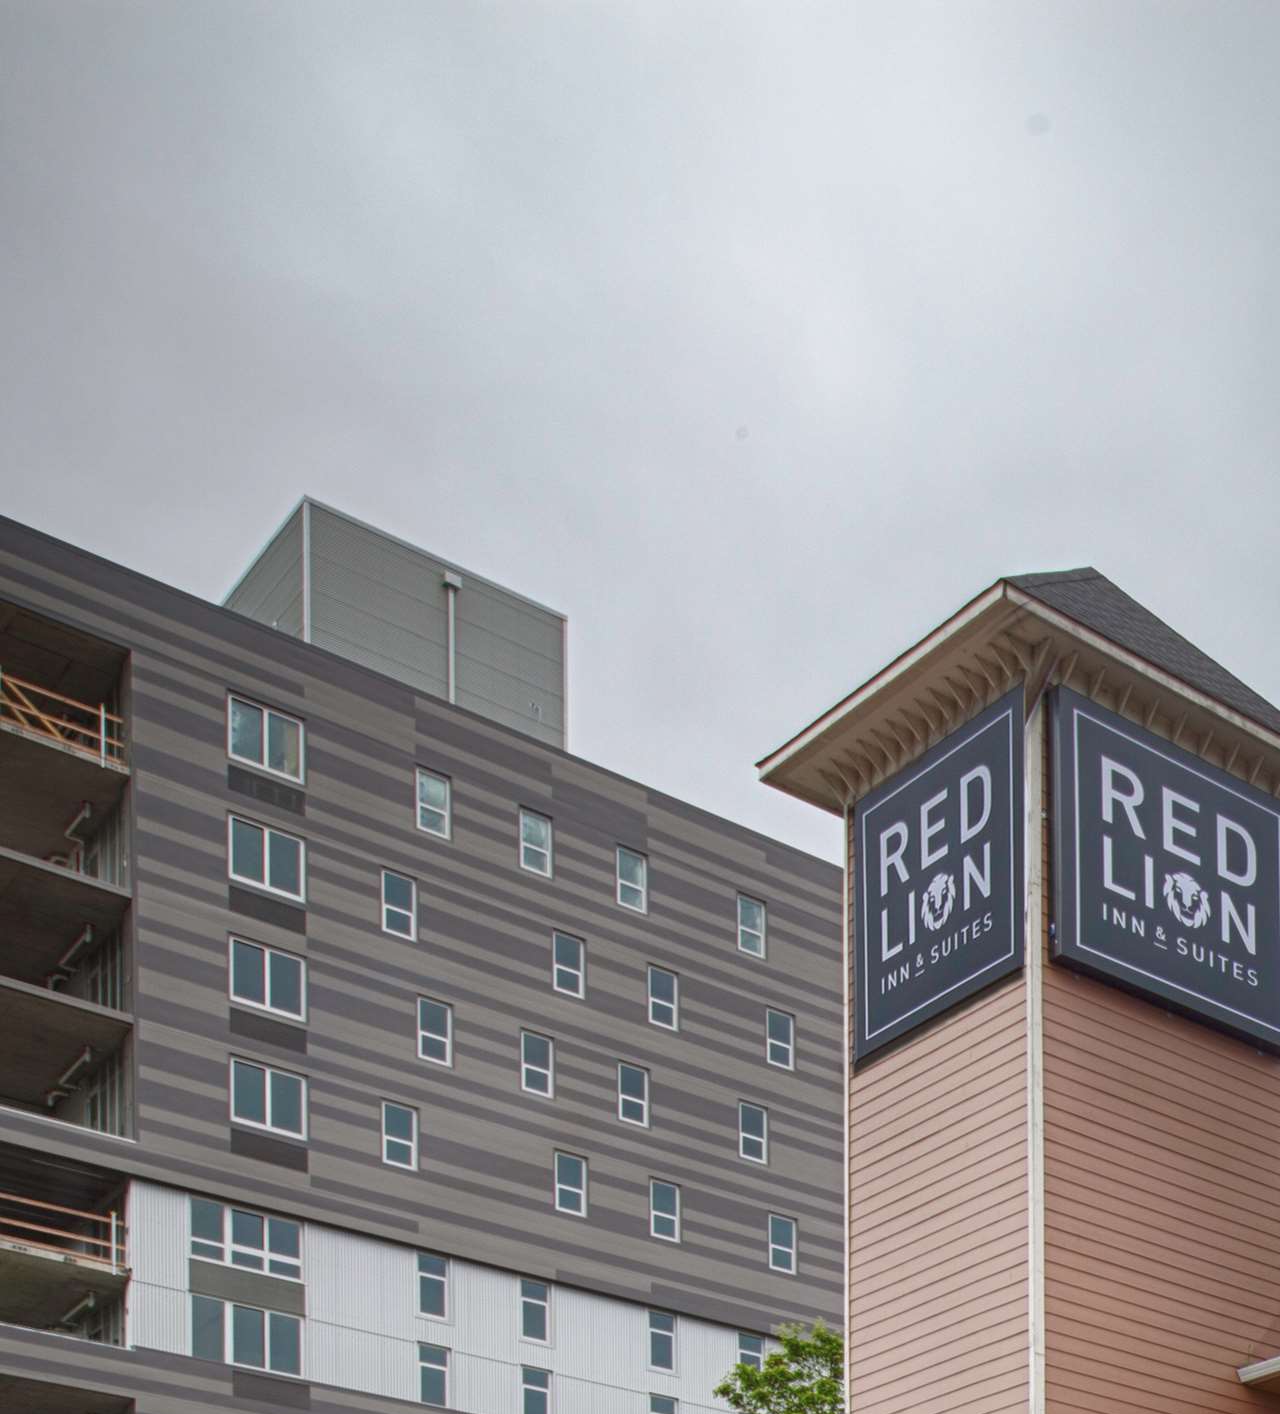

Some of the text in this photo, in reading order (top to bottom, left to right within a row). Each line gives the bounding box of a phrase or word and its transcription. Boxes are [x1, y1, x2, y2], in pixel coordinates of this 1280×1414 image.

[880, 764, 992, 897] RED
[1101, 754, 1257, 887] RED
[881, 912, 992, 994] INN & SUITES
[1103, 903, 1259, 986] INN & SUITES
